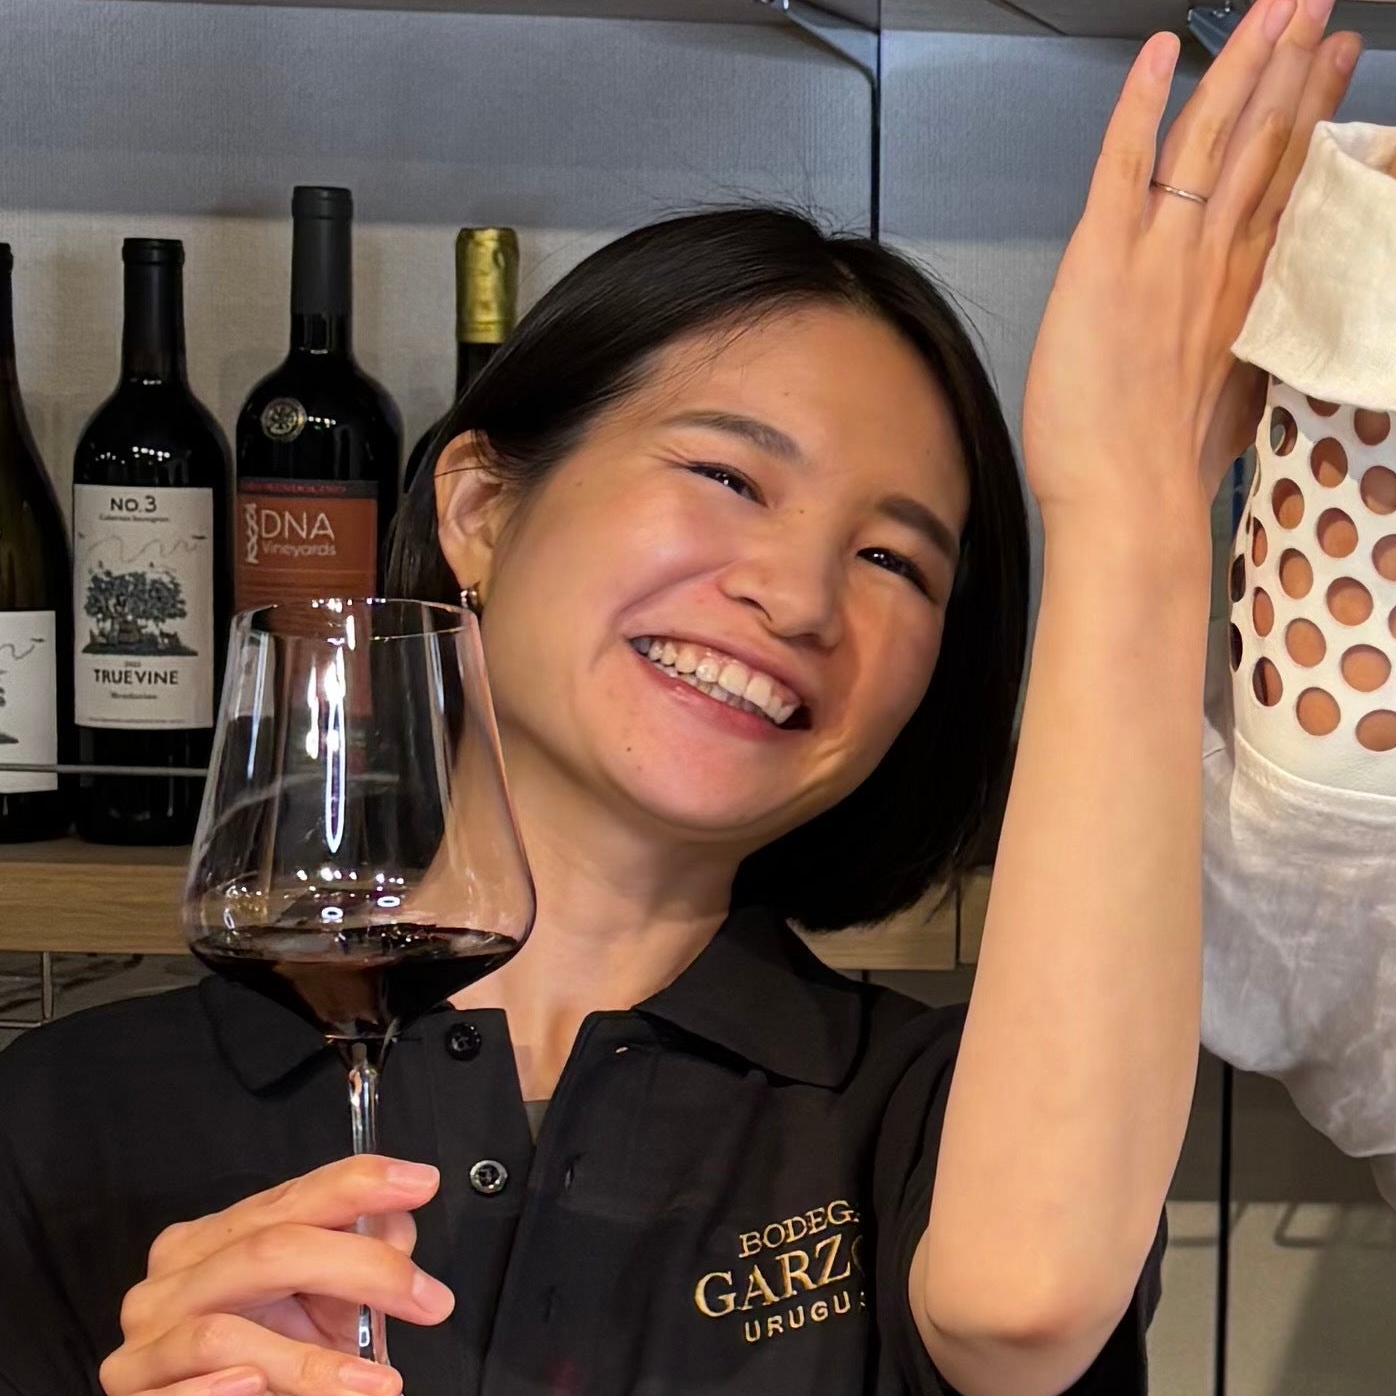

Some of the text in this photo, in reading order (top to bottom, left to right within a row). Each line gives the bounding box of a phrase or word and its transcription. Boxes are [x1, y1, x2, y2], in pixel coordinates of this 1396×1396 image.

[261, 509, 335, 540] DNA
[262, 541, 337, 557] Vineyards
[738, 1200, 860, 1259] BODEG
[694, 1233, 864, 1318] GARZ
[744, 1291, 866, 1343] URUGU
